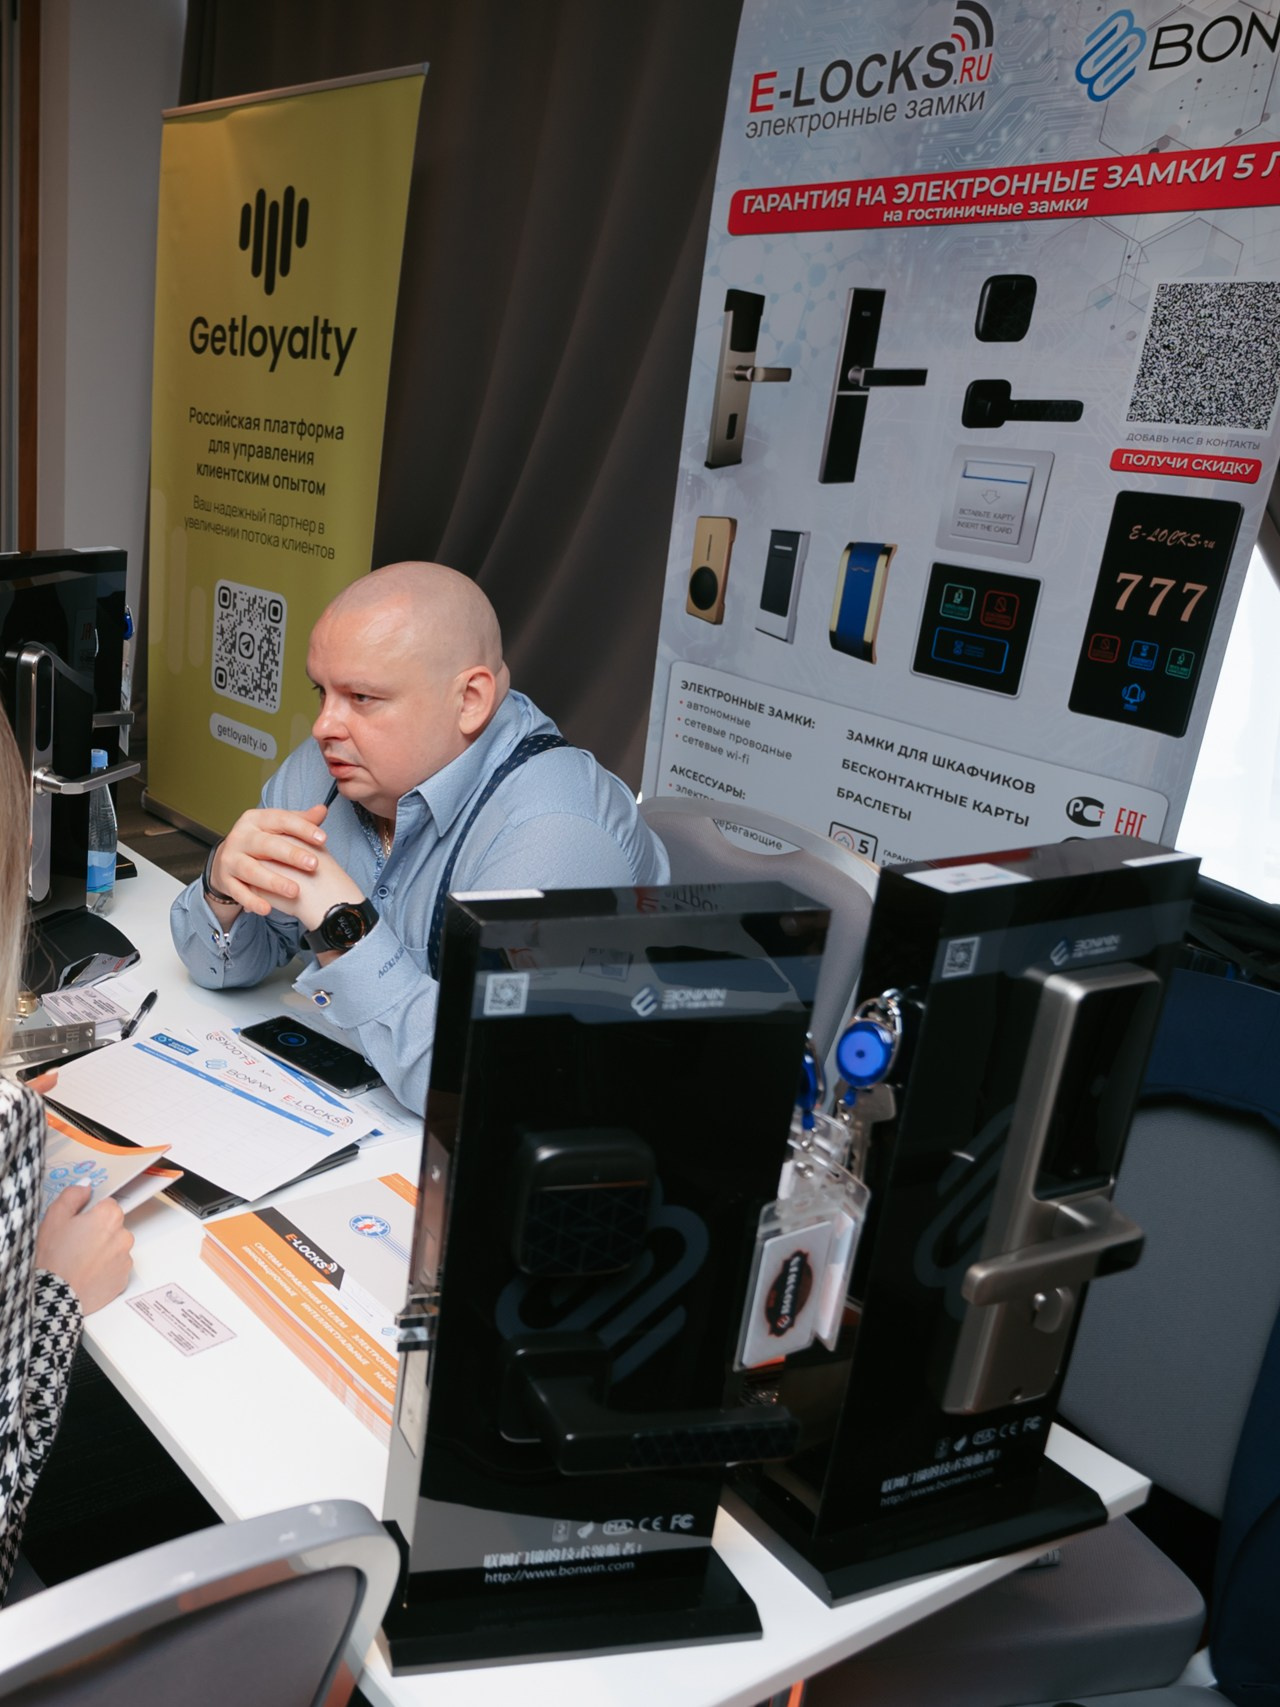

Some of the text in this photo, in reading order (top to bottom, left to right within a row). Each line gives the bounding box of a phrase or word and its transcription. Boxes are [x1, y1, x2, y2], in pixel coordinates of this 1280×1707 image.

[745, 90, 986, 139] электронные замки
[742, 187, 852, 215] ГАРАНТИЯ
[855, 184, 887, 207] НА
[892, 167, 1099, 205] ЭЛЕКТРОННЫЕ
[1103, 155, 1227, 190] ЗАМКИ
[1232, 153, 1256, 180] 5
[883, 198, 1089, 223] на гостиничные замки
[189, 314, 358, 377] Getloyalty
[188, 406, 345, 442] Российская платформа
[1125, 432, 1261, 450] ДОБАВЬ НАС В КОНТАКТЫ
[208, 437, 315, 466] для управления
[1121, 453, 1255, 475] ПОЛУЧИ СКИДКУ
[195, 462, 326, 496] клиентским опытом
[193, 494, 325, 536] Ваш надежный партнер в
[980, 524, 993, 532] THE
[993, 526, 1013, 535] CARD
[184, 514, 335, 560] увеличении потока клиентов
[680, 680, 816, 729] ЭЛЕКТРОННЫЕ ЗАМКИ:
[686, 700, 751, 728] автономные
[217, 722, 268, 754] getloyalty.io
[682, 734, 750, 765] сетевые wi-fi
[684, 717, 793, 760] сетевые проводные
[845, 729, 1036, 795] ЗАМКИ ДЛЯ ШКАФЧИКОВ
[670, 764, 746, 800] АКСЕССУАРЫ:
[841, 758, 1030, 827] БЕСКОНТАКТНЫЕ КАРТЫ
[836, 786, 912, 822] БРАСЛЕТЫ
[857, 839, 870, 855] 5
[484, 1560, 636, 1584] http://www.bonwin.com
